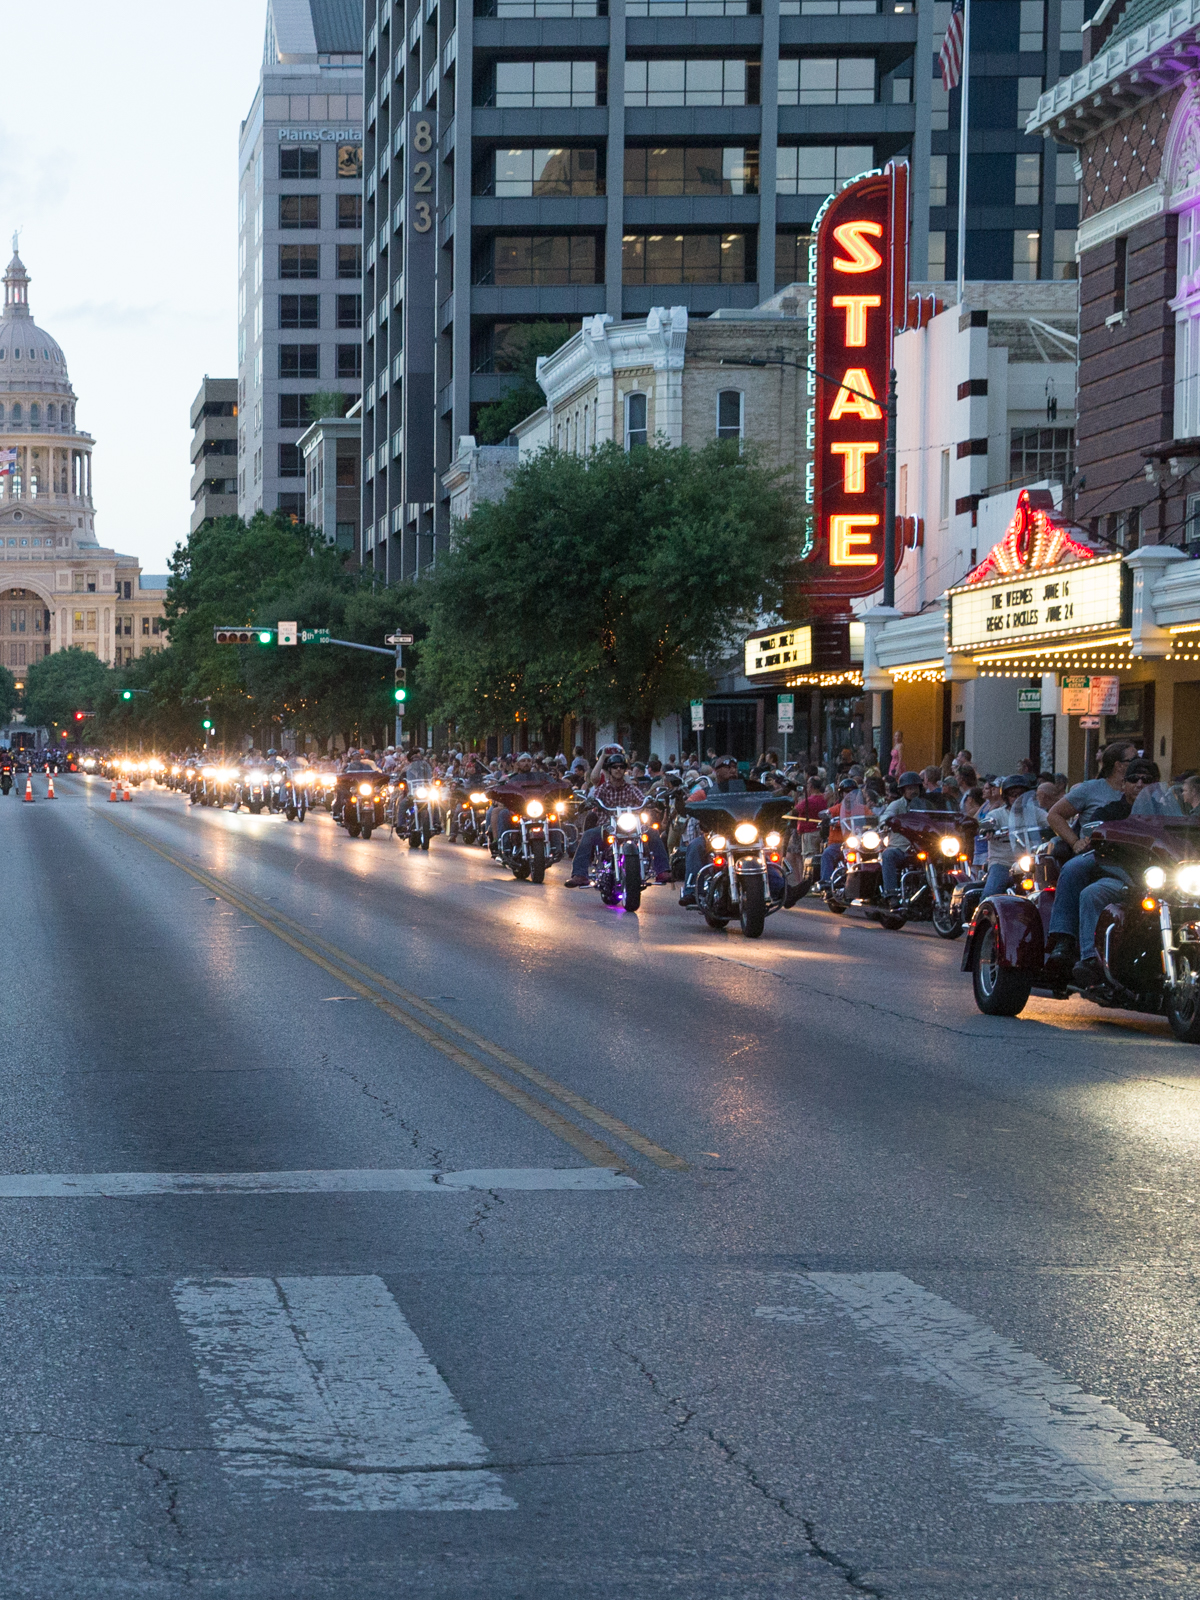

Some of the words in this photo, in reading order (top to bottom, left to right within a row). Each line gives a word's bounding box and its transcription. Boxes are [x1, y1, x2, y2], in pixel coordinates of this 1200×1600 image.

[278, 128, 363, 142] PlainsCapita
[413, 120, 432, 233] 823
[829, 220, 883, 566] STATE
[302, 630, 314, 642] 8th
[1020, 692, 1040, 700] ATM
